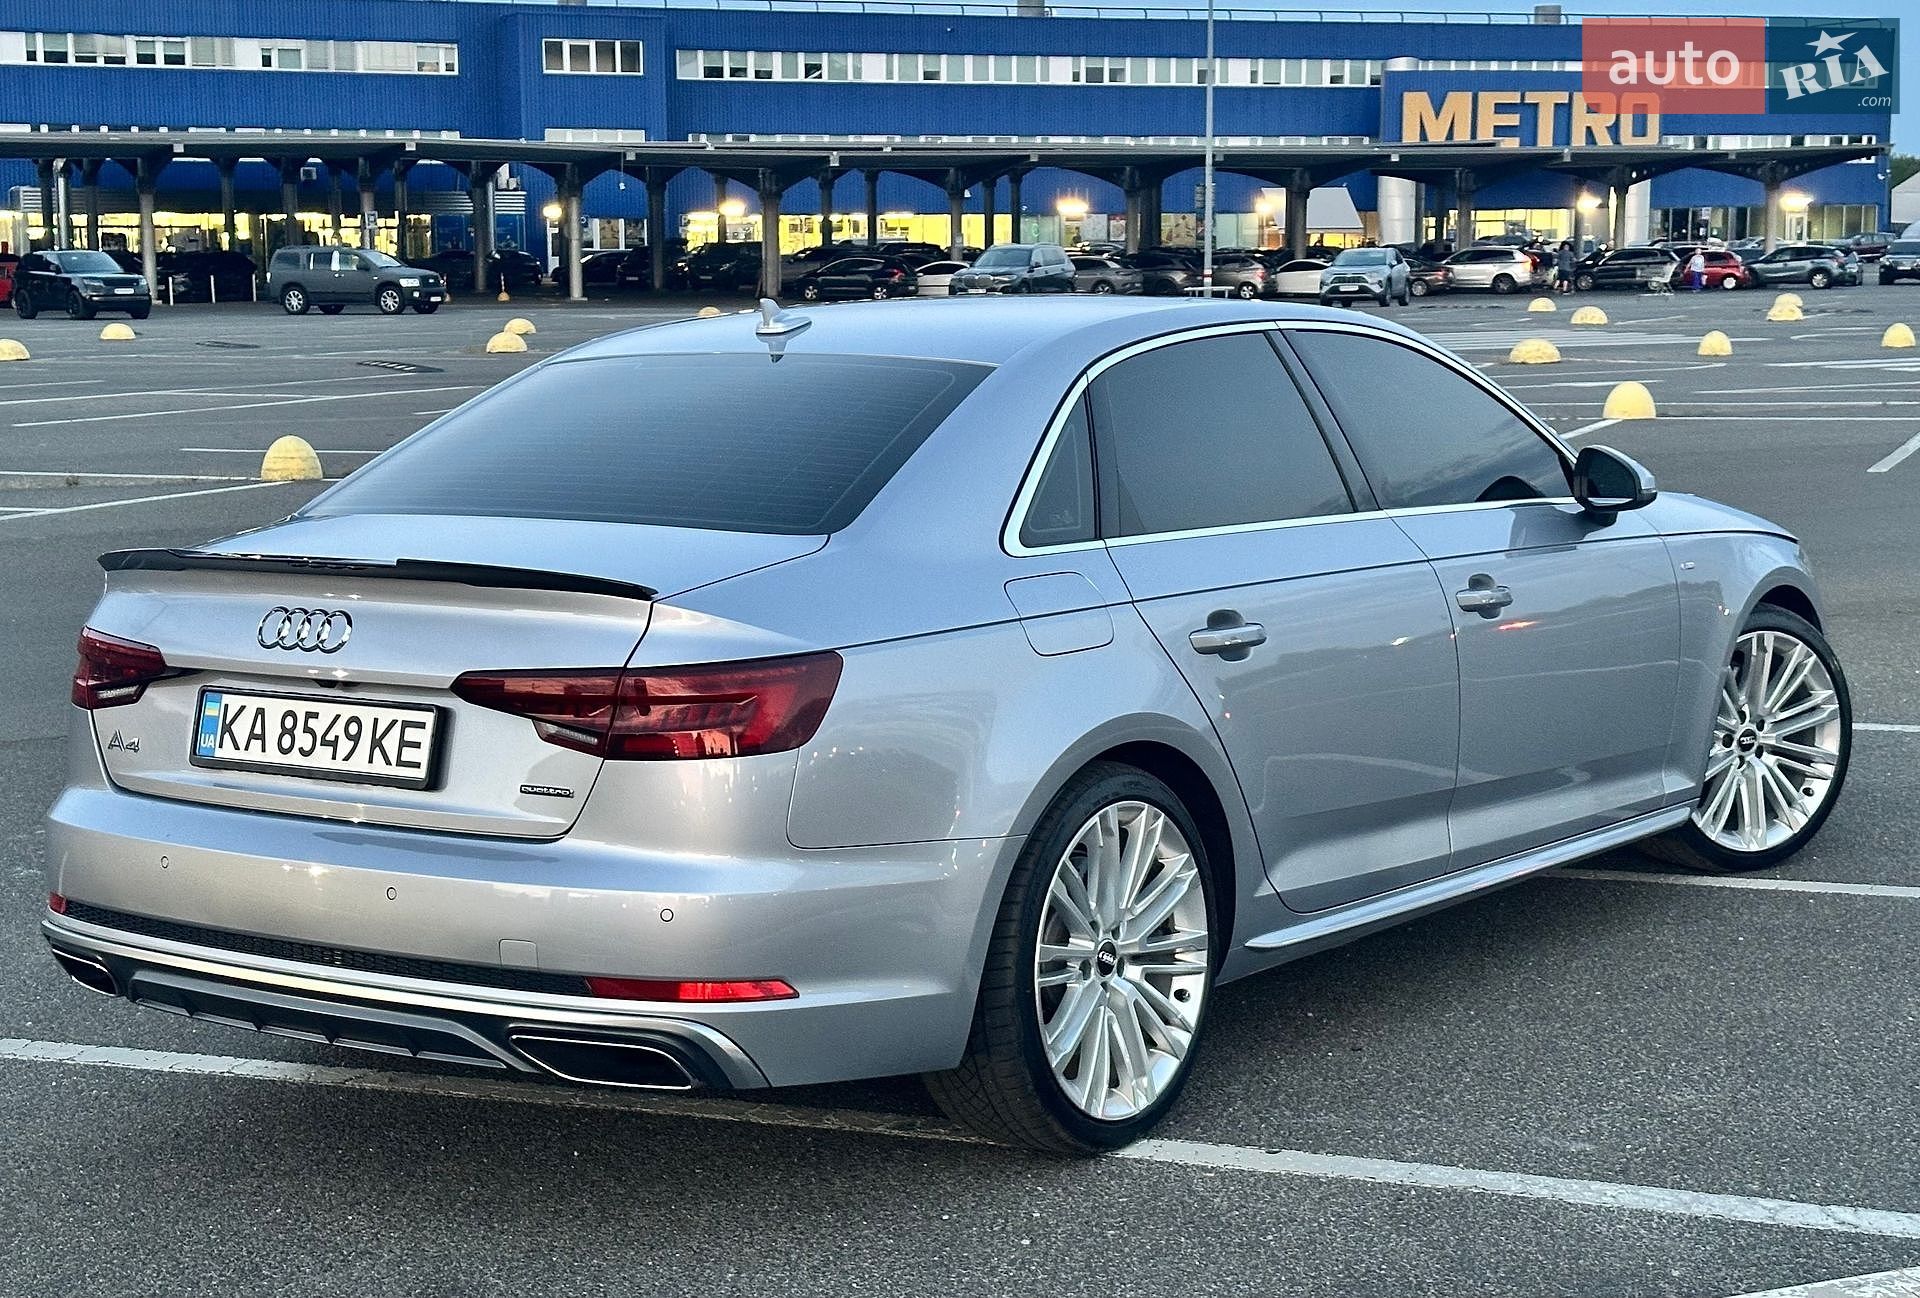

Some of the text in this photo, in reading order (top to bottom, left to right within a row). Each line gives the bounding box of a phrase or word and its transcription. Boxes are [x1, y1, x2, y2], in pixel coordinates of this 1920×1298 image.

[1402, 91, 1661, 147] METRO
[107, 729, 140, 753] A4
[200, 733, 216, 749] UA
[218, 703, 427, 769] KA 8549 KE
